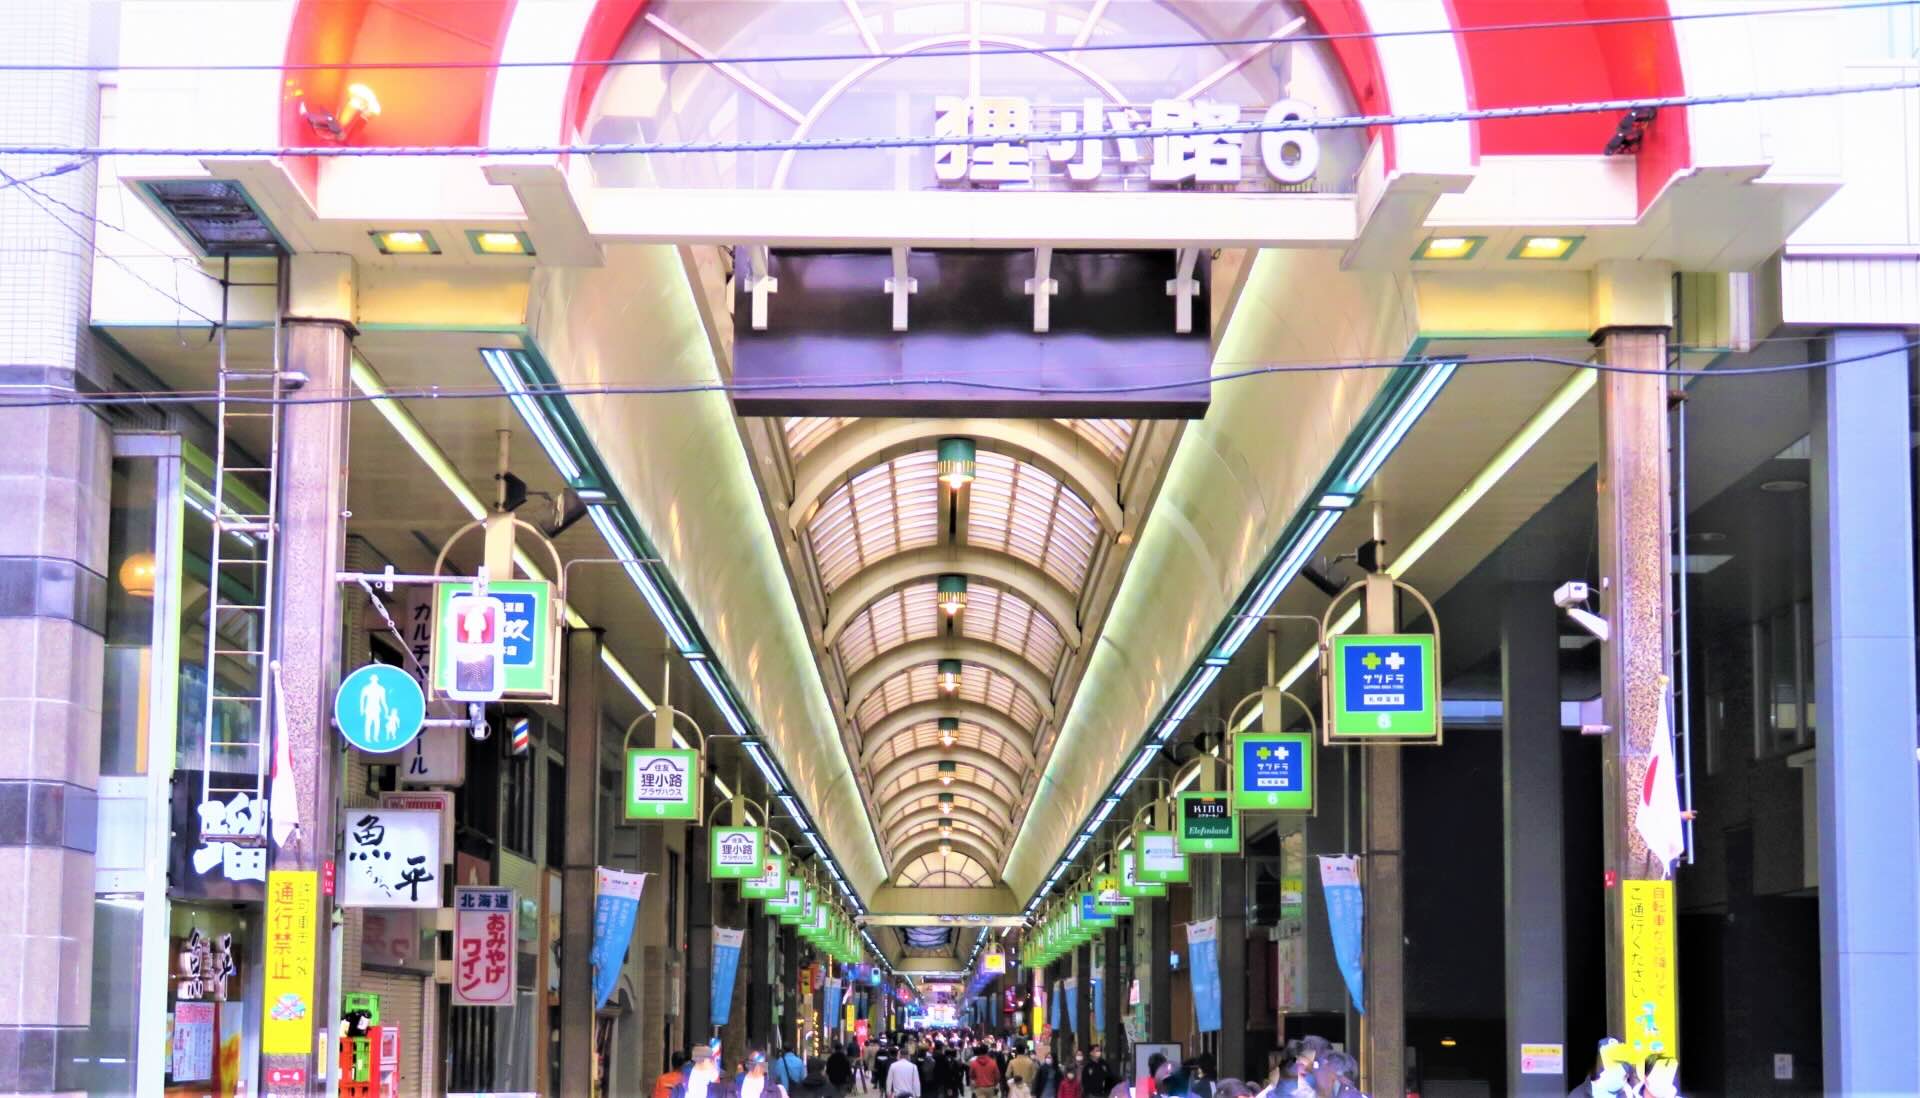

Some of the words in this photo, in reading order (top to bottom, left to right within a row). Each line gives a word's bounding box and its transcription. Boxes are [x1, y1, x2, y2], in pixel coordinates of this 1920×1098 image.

[934, 96, 1320, 186] 狸小路6
[640, 774, 683, 788] 狸小路
[348, 814, 434, 902] 魚平
[722, 845, 753, 855] 狸小路
[271, 880, 294, 981] 通行禁止
[460, 894, 510, 909] 北海道
[461, 937, 482, 993] ワイン
[485, 912, 507, 985] おみやげ
[1631, 887, 1645, 998] ご通行ください
